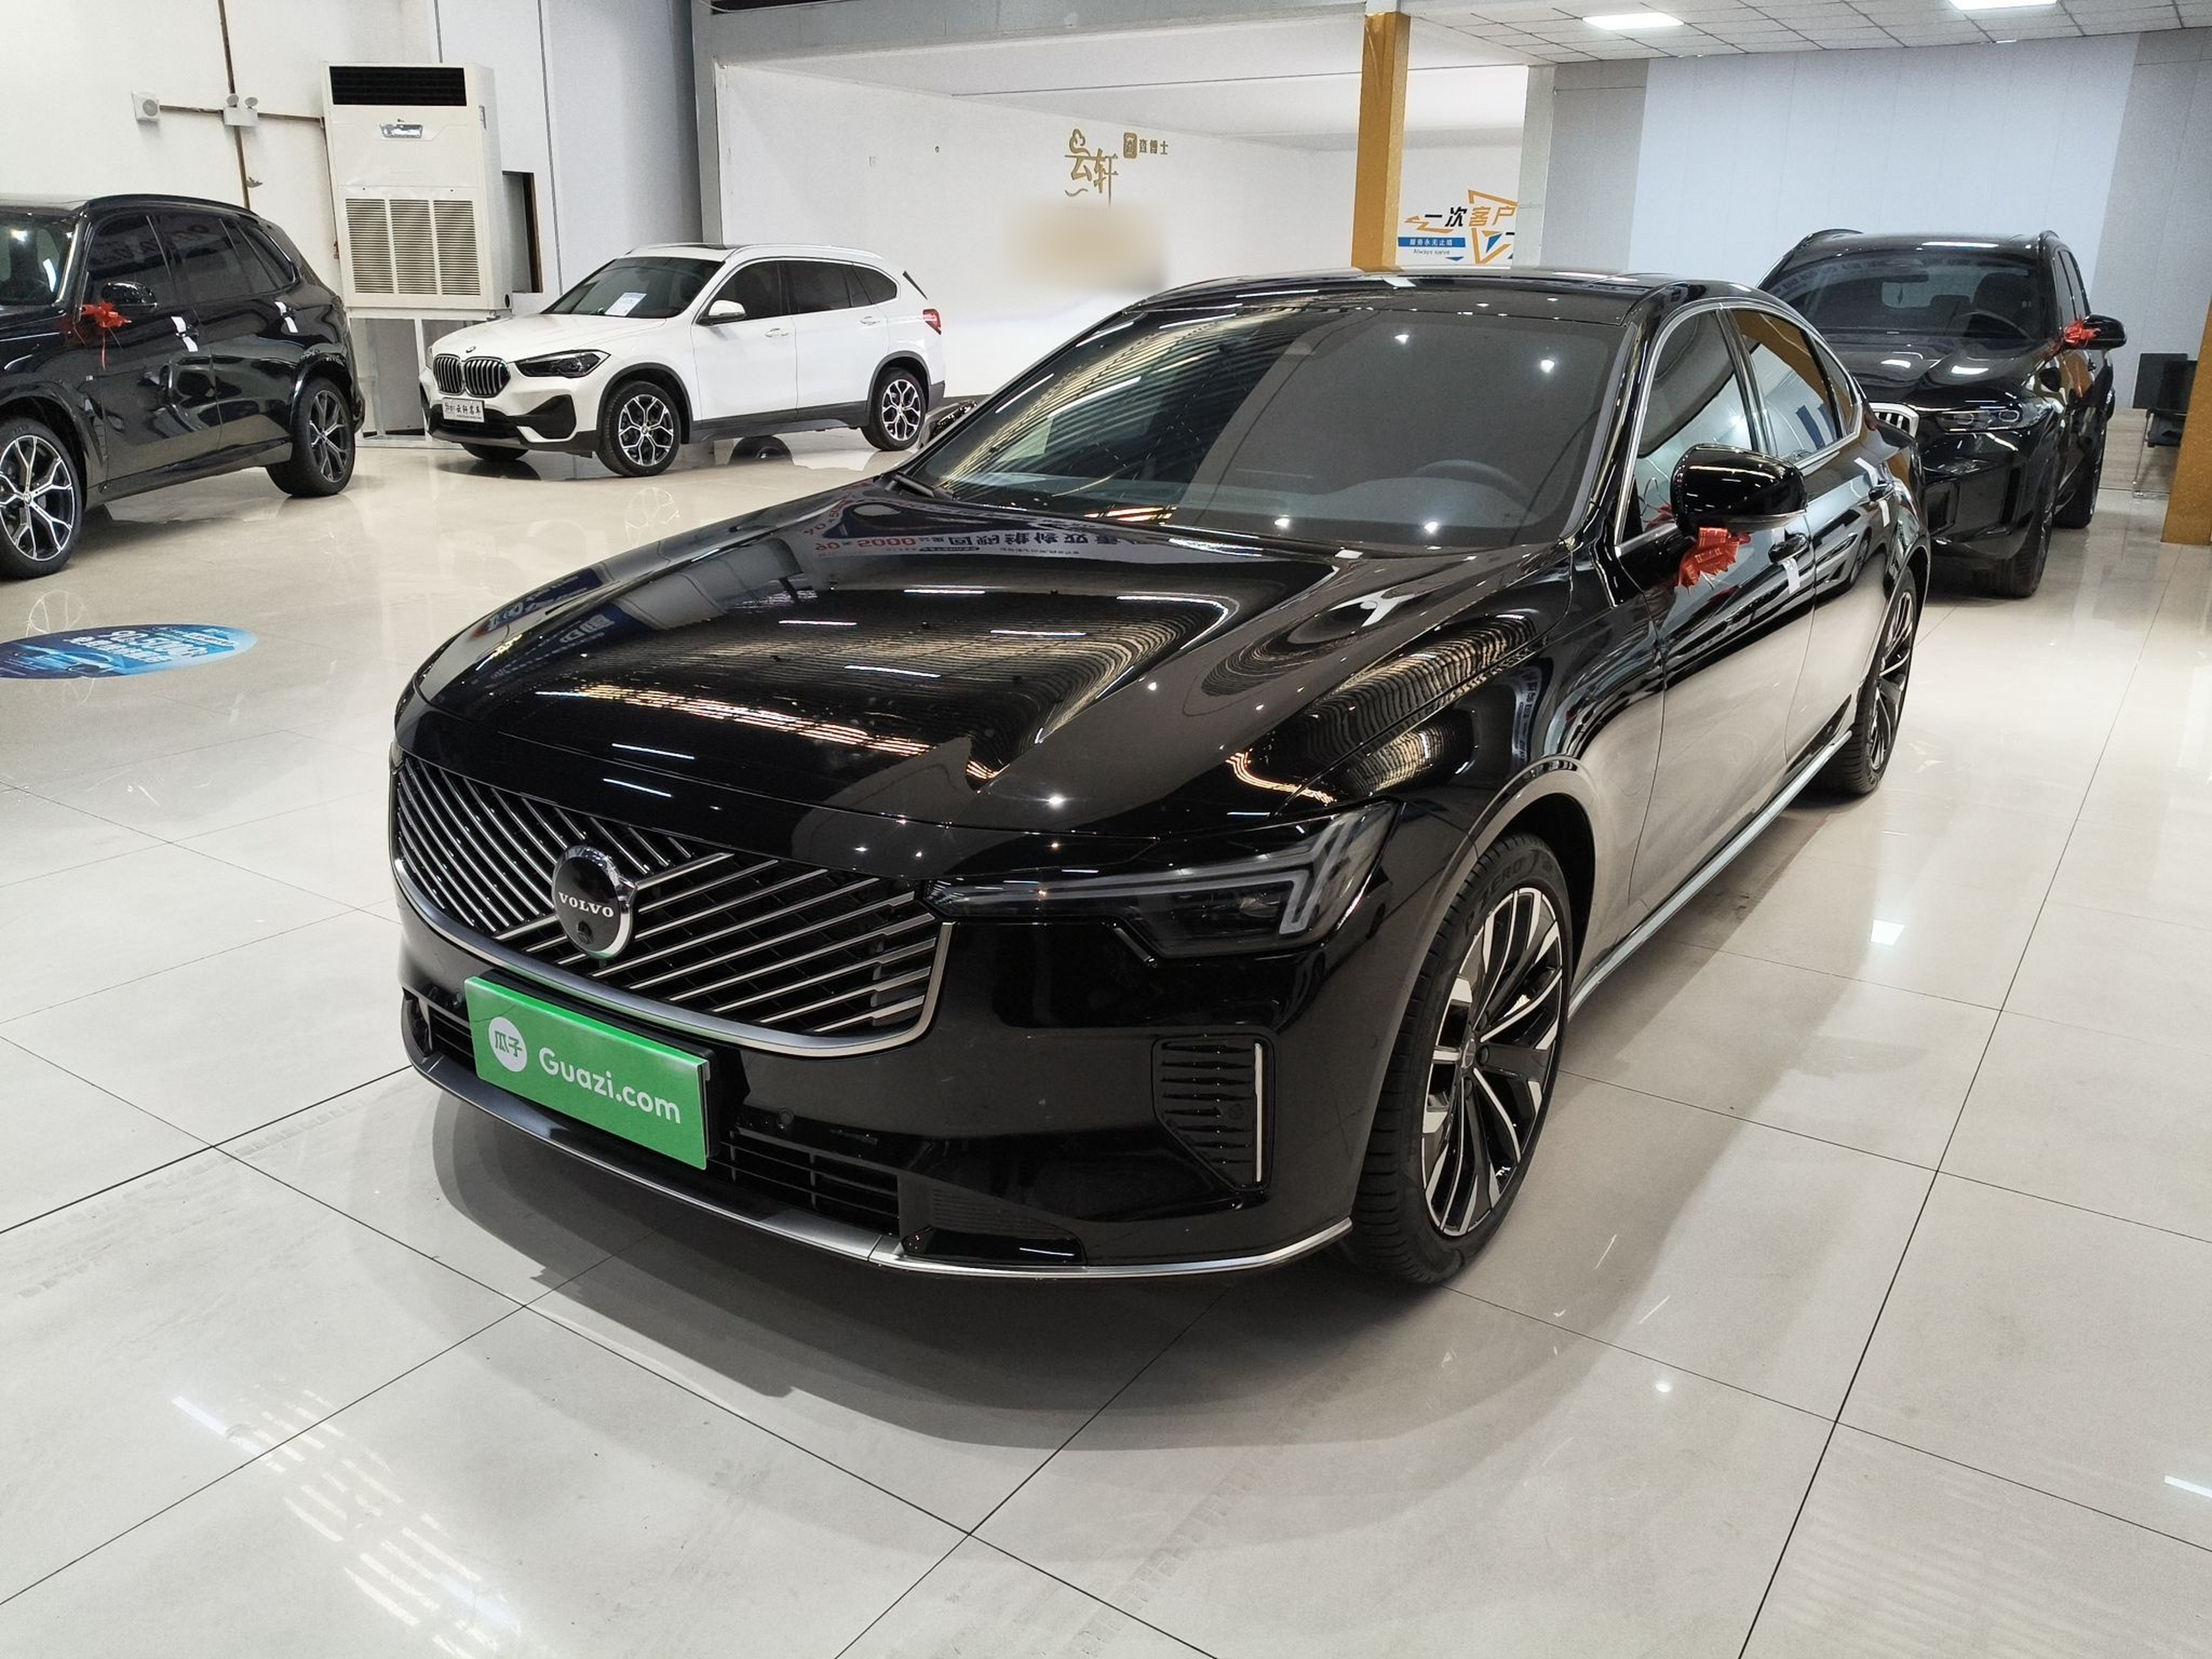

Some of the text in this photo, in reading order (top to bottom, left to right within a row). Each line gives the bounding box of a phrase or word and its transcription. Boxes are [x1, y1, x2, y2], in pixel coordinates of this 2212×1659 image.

[1424, 206, 1516, 228] 一次客户
[558, 891, 614, 918] VOLVO
[494, 1030, 522, 1058] 瓜子
[538, 1047, 681, 1124] Guazi.com
